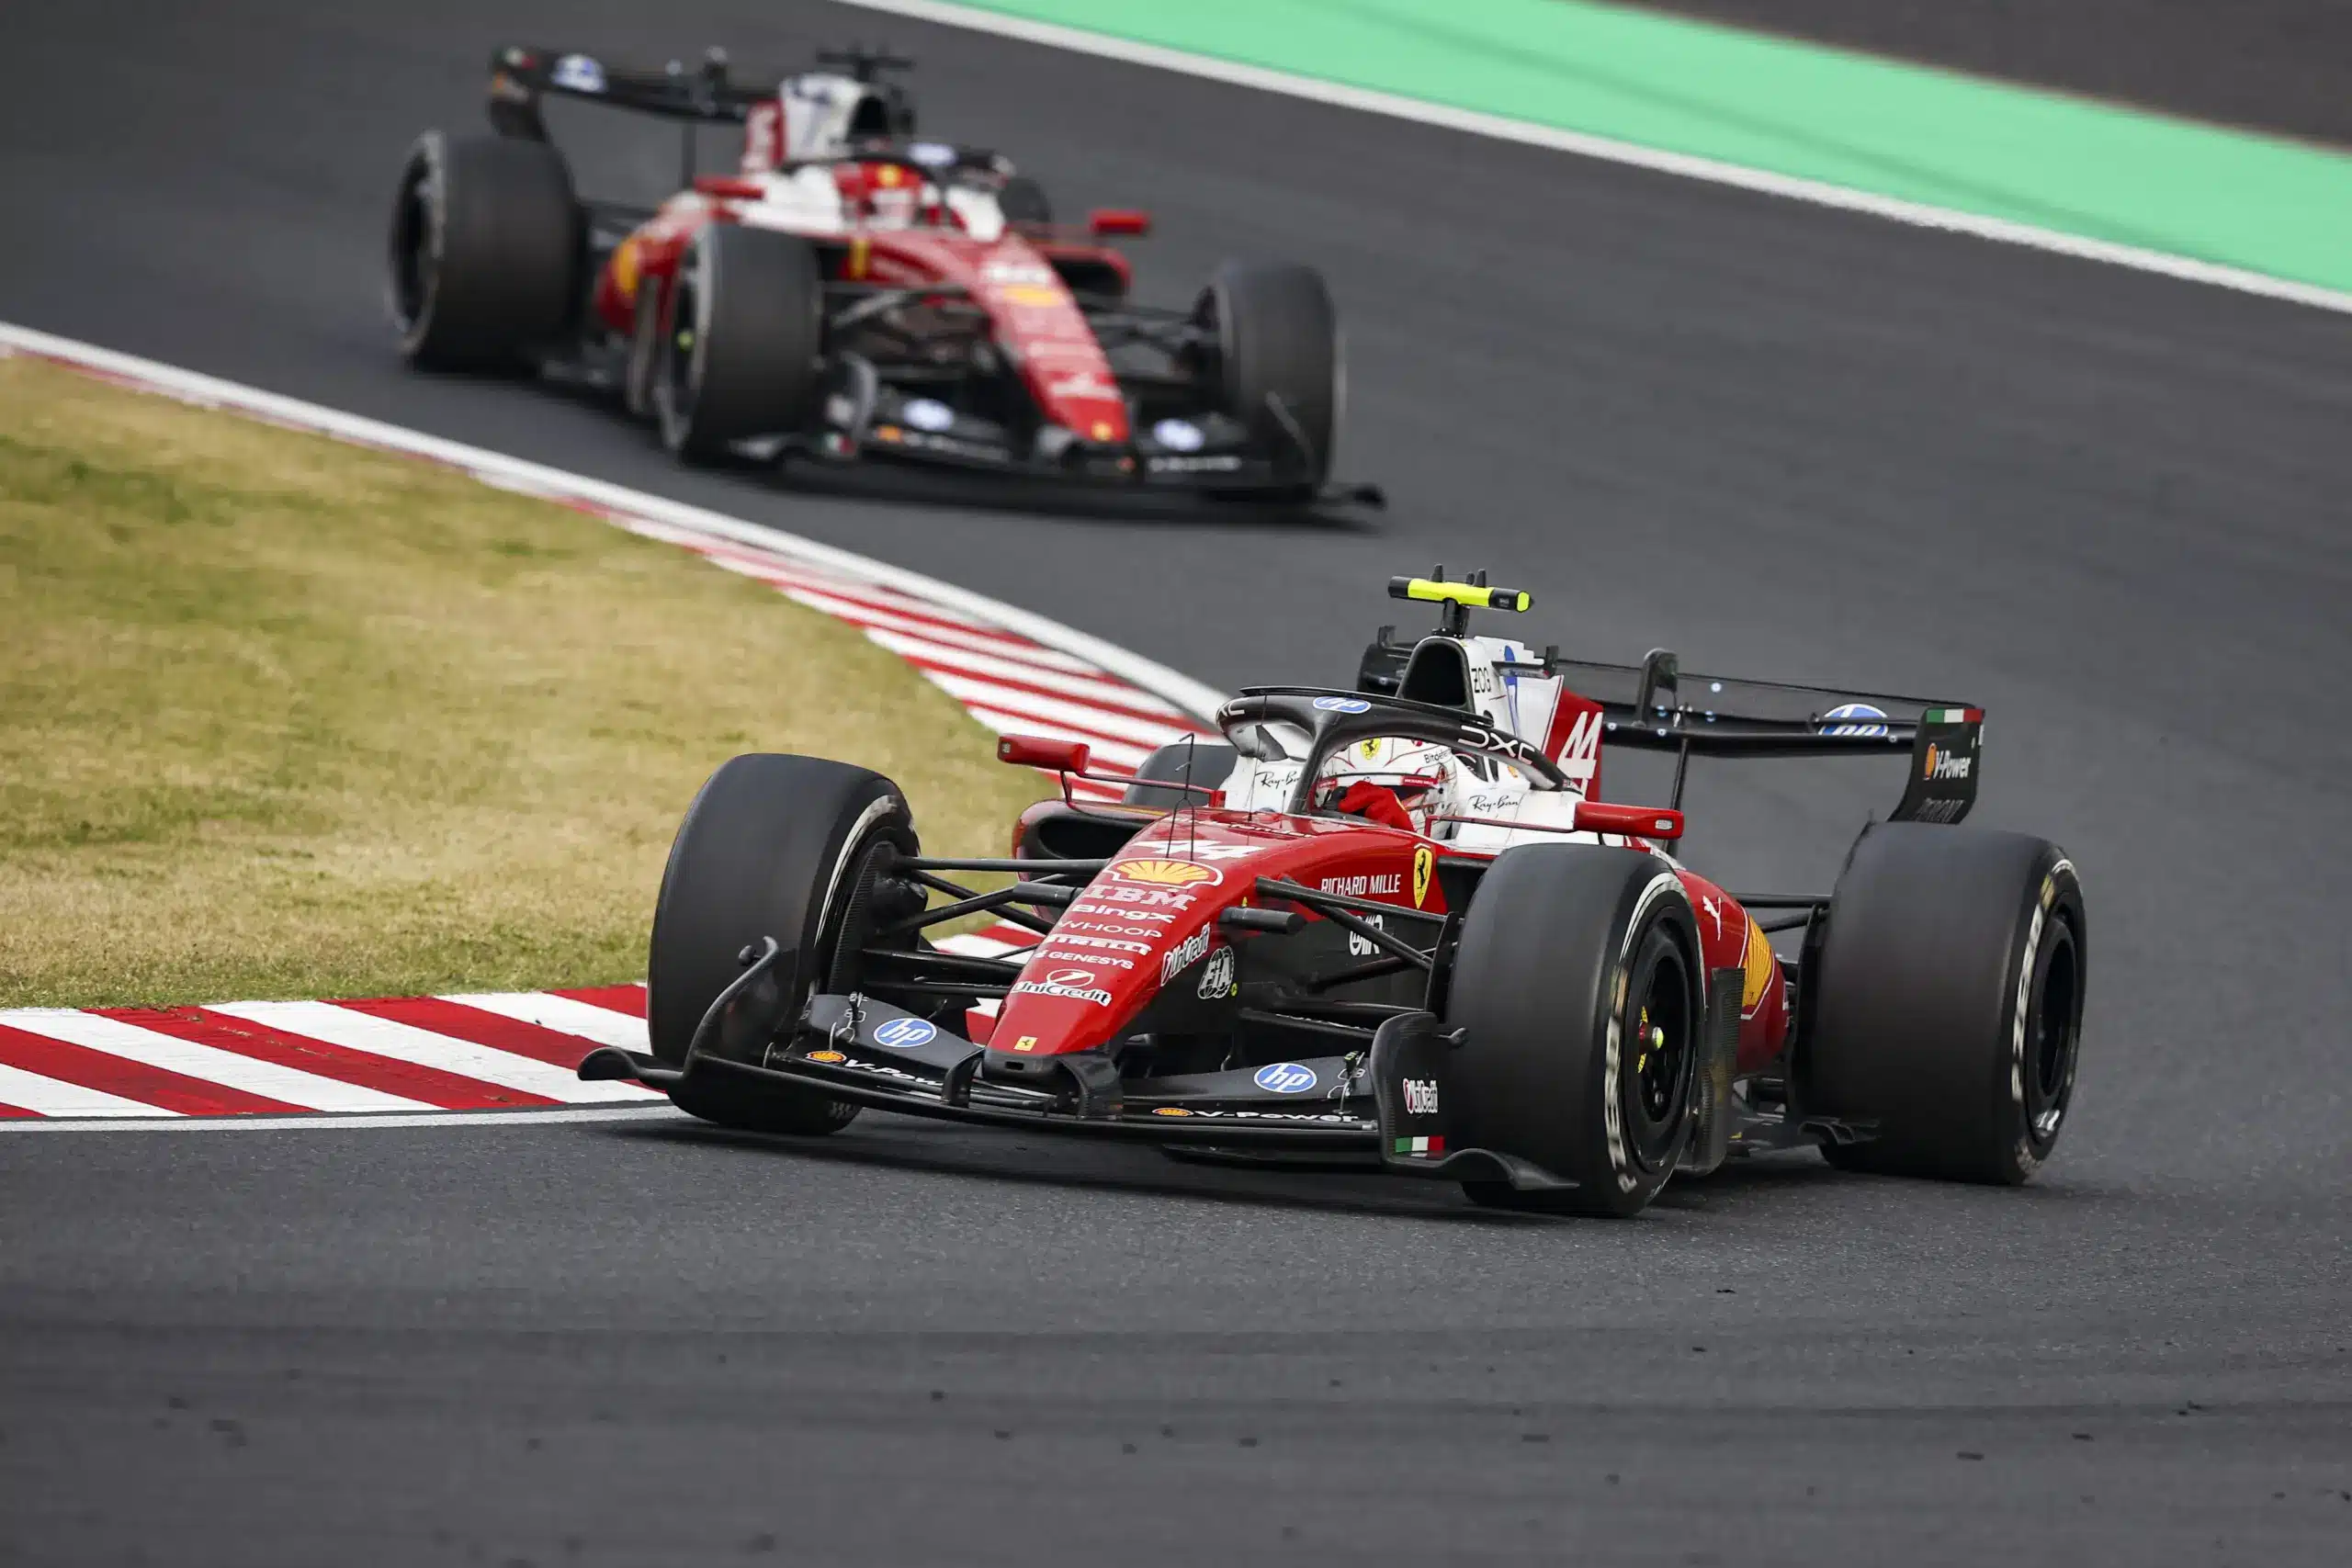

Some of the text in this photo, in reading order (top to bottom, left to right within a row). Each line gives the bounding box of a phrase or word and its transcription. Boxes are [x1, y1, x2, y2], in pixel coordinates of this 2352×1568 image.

[1458, 725, 1535, 765] DXC
[1556, 711, 1603, 800] 44
[1933, 750, 1972, 779] V-Power
[1468, 795, 1520, 813] Ray-Ban
[1131, 840, 1268, 860] 44
[1083, 885, 1197, 911] IBM
[1320, 874, 1401, 897] RICHARD MILLE
[1057, 919, 1162, 938] WHOOP
[1043, 933, 1152, 956] PIRELLI
[1047, 951, 1135, 970] GENESYS
[1200, 955, 1232, 990] FIA
[1012, 981, 1112, 1007] UniCredit
[877, 1018, 933, 1047] hp
[844, 1059, 944, 1087] V-Pow
[1261, 1063, 1311, 1092] hp
[1194, 1111, 1360, 1122] V-Power
